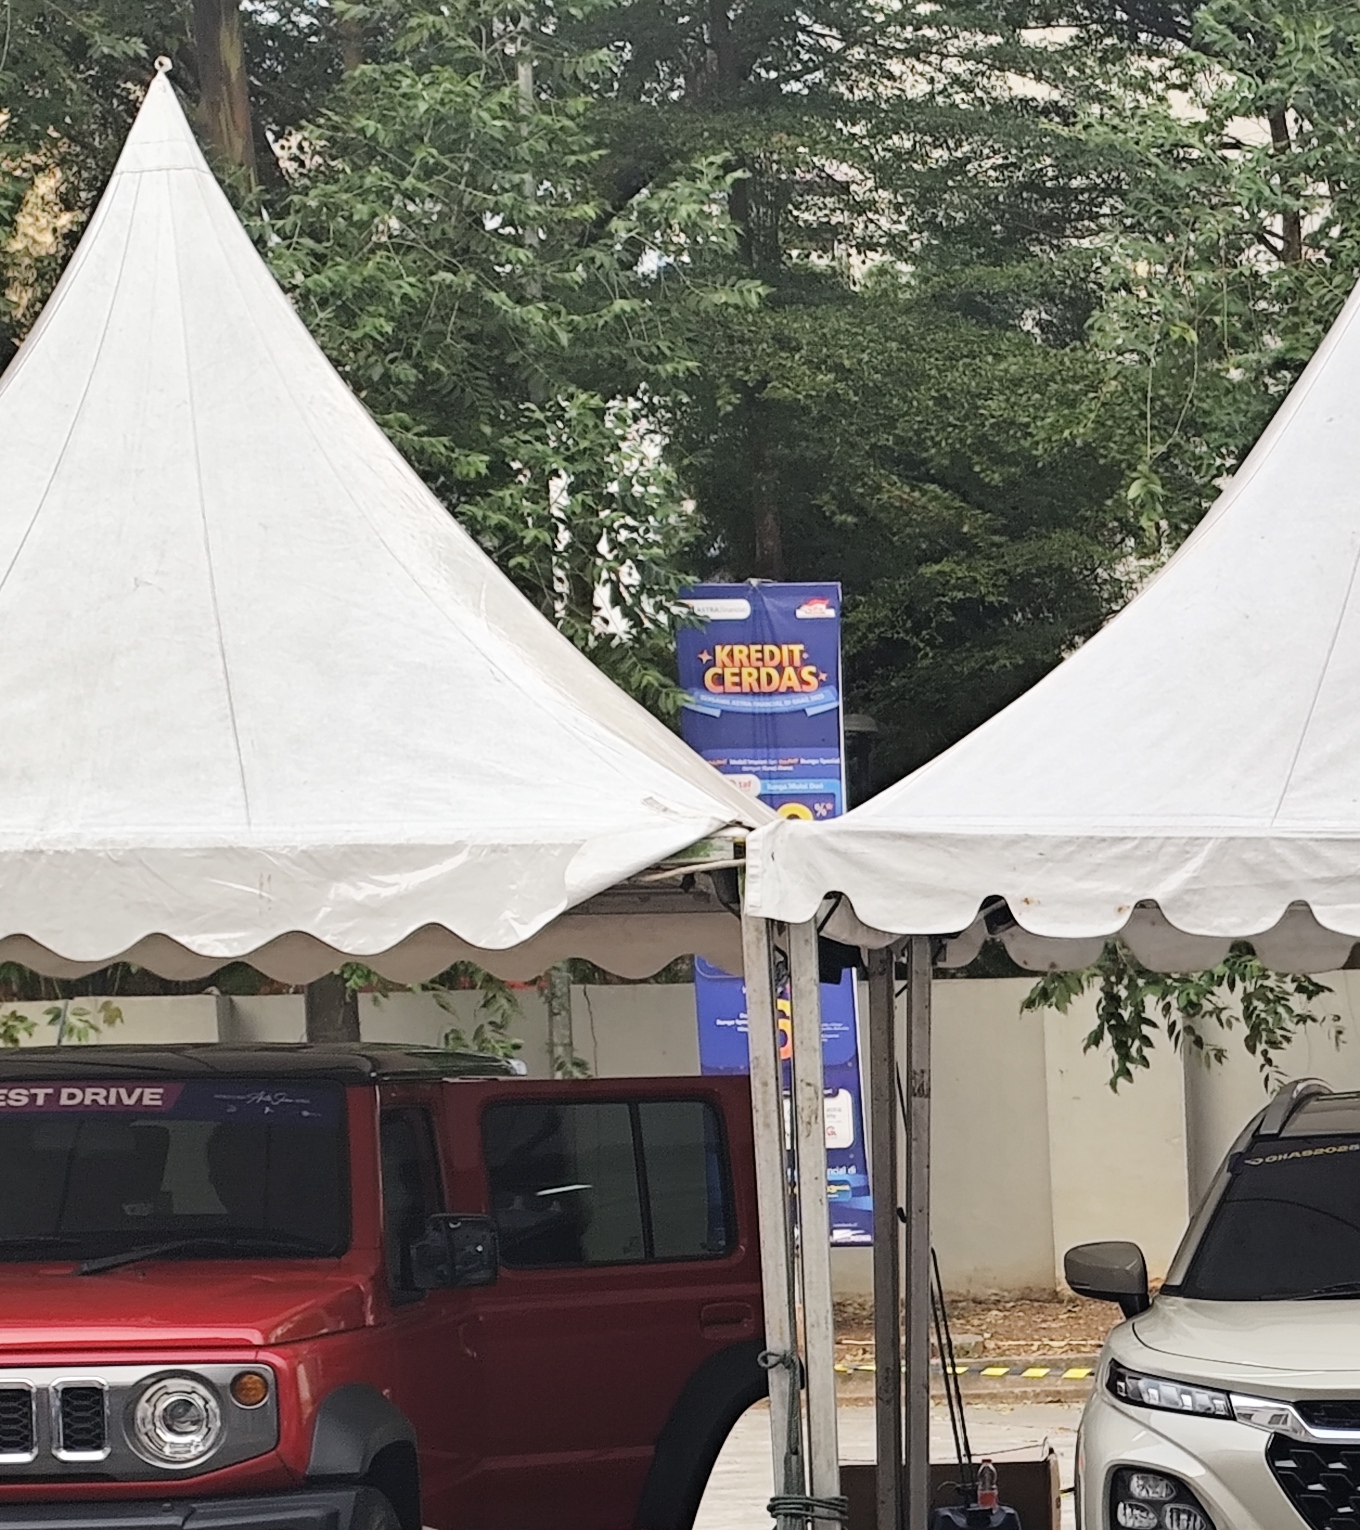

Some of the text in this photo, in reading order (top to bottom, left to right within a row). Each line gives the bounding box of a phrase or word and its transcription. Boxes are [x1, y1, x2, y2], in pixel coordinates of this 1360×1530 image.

[714, 644, 805, 667] KREDIT
[704, 665, 819, 693] CERDAS
[59, 1087, 164, 1106] DRIVE
